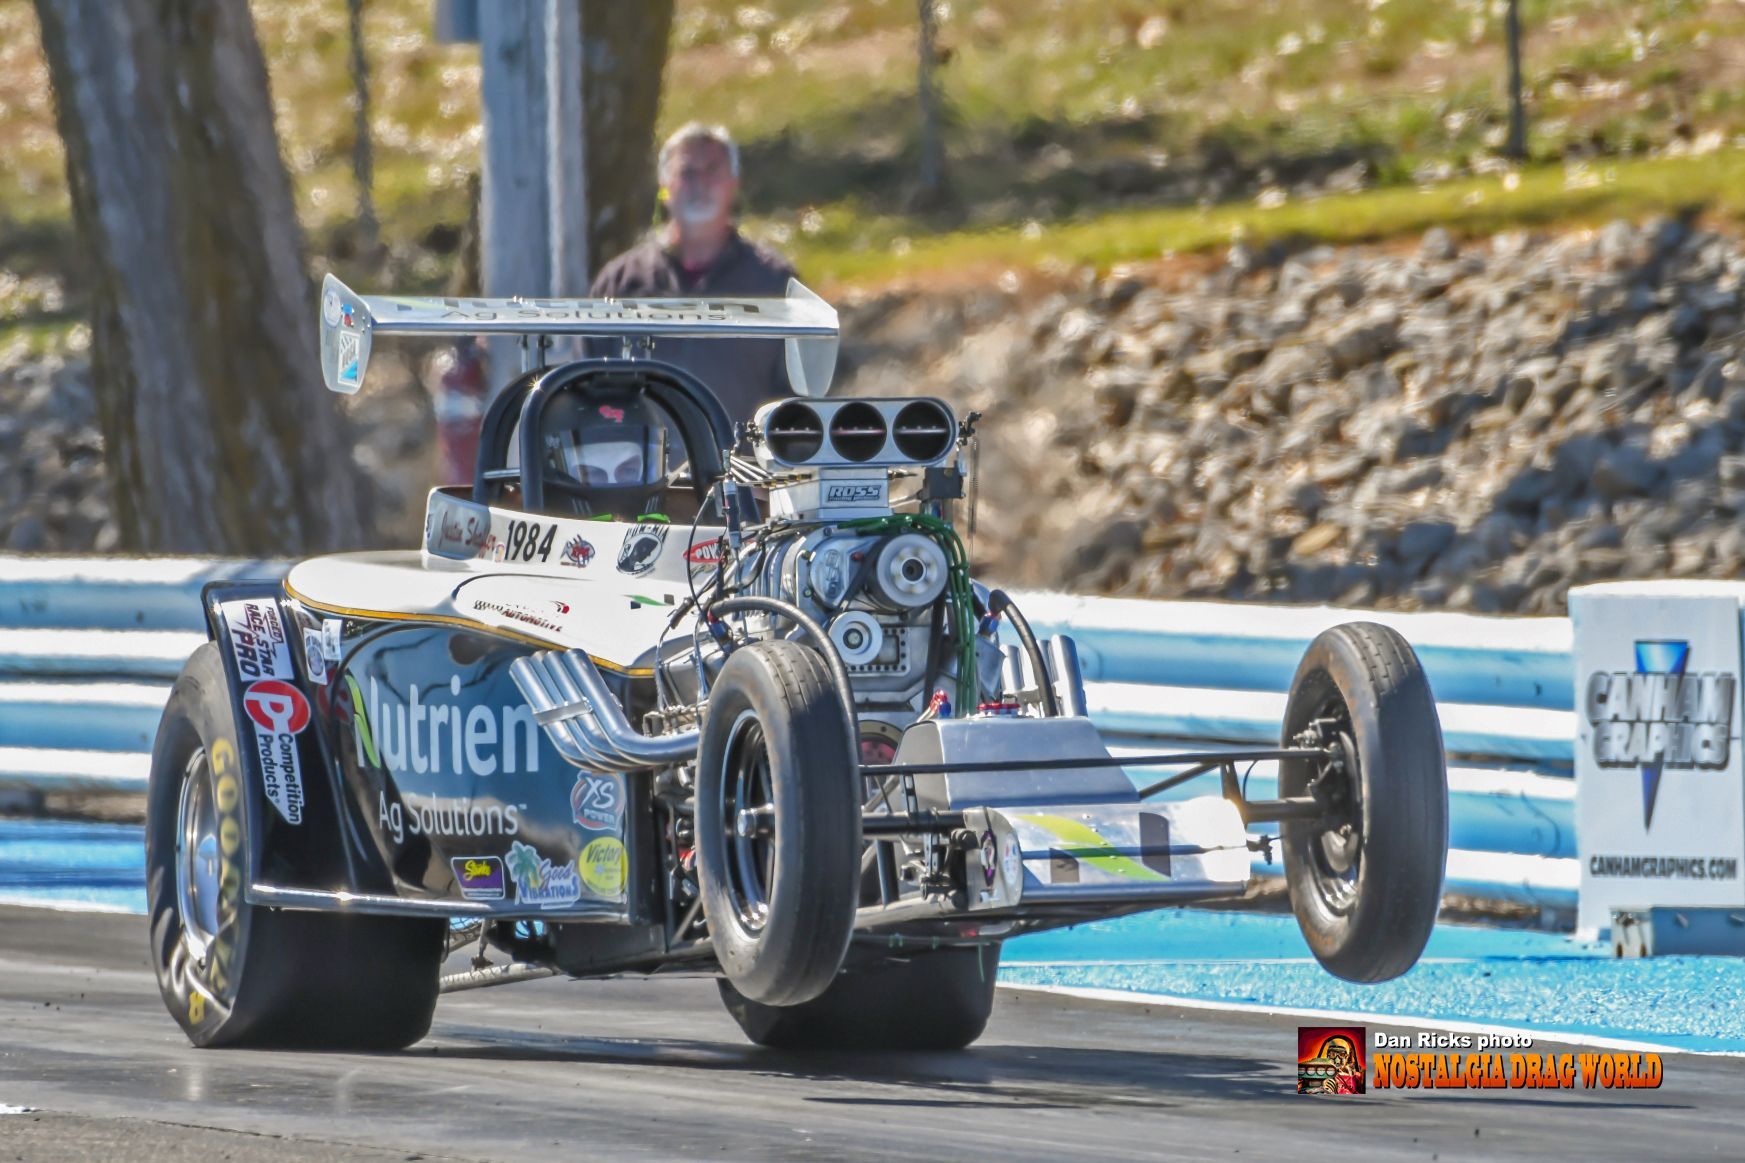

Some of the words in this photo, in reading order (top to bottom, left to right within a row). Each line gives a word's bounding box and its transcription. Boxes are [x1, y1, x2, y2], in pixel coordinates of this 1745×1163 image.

[516, 309, 728, 321] Solutions
[828, 485, 882, 498] ROSS
[504, 519, 558, 563] 1984
[246, 602, 266, 636] RACE
[257, 636, 277, 678] STAR
[266, 605, 285, 644] FORGED
[231, 628, 262, 679] PRO
[1587, 671, 1736, 723] CANHAM
[345, 674, 540, 777] Nutrien
[1593, 721, 1732, 770] GRAPHICS
[257, 732, 280, 799] Products
[277, 732, 303, 824] Competition
[579, 776, 616, 810] XS
[378, 790, 405, 845] Ag
[583, 808, 616, 825] POWER
[539, 858, 574, 889] Good
[585, 843, 623, 864] Victory
[1589, 854, 1738, 879] CANHAMGRAPHICS.COM
